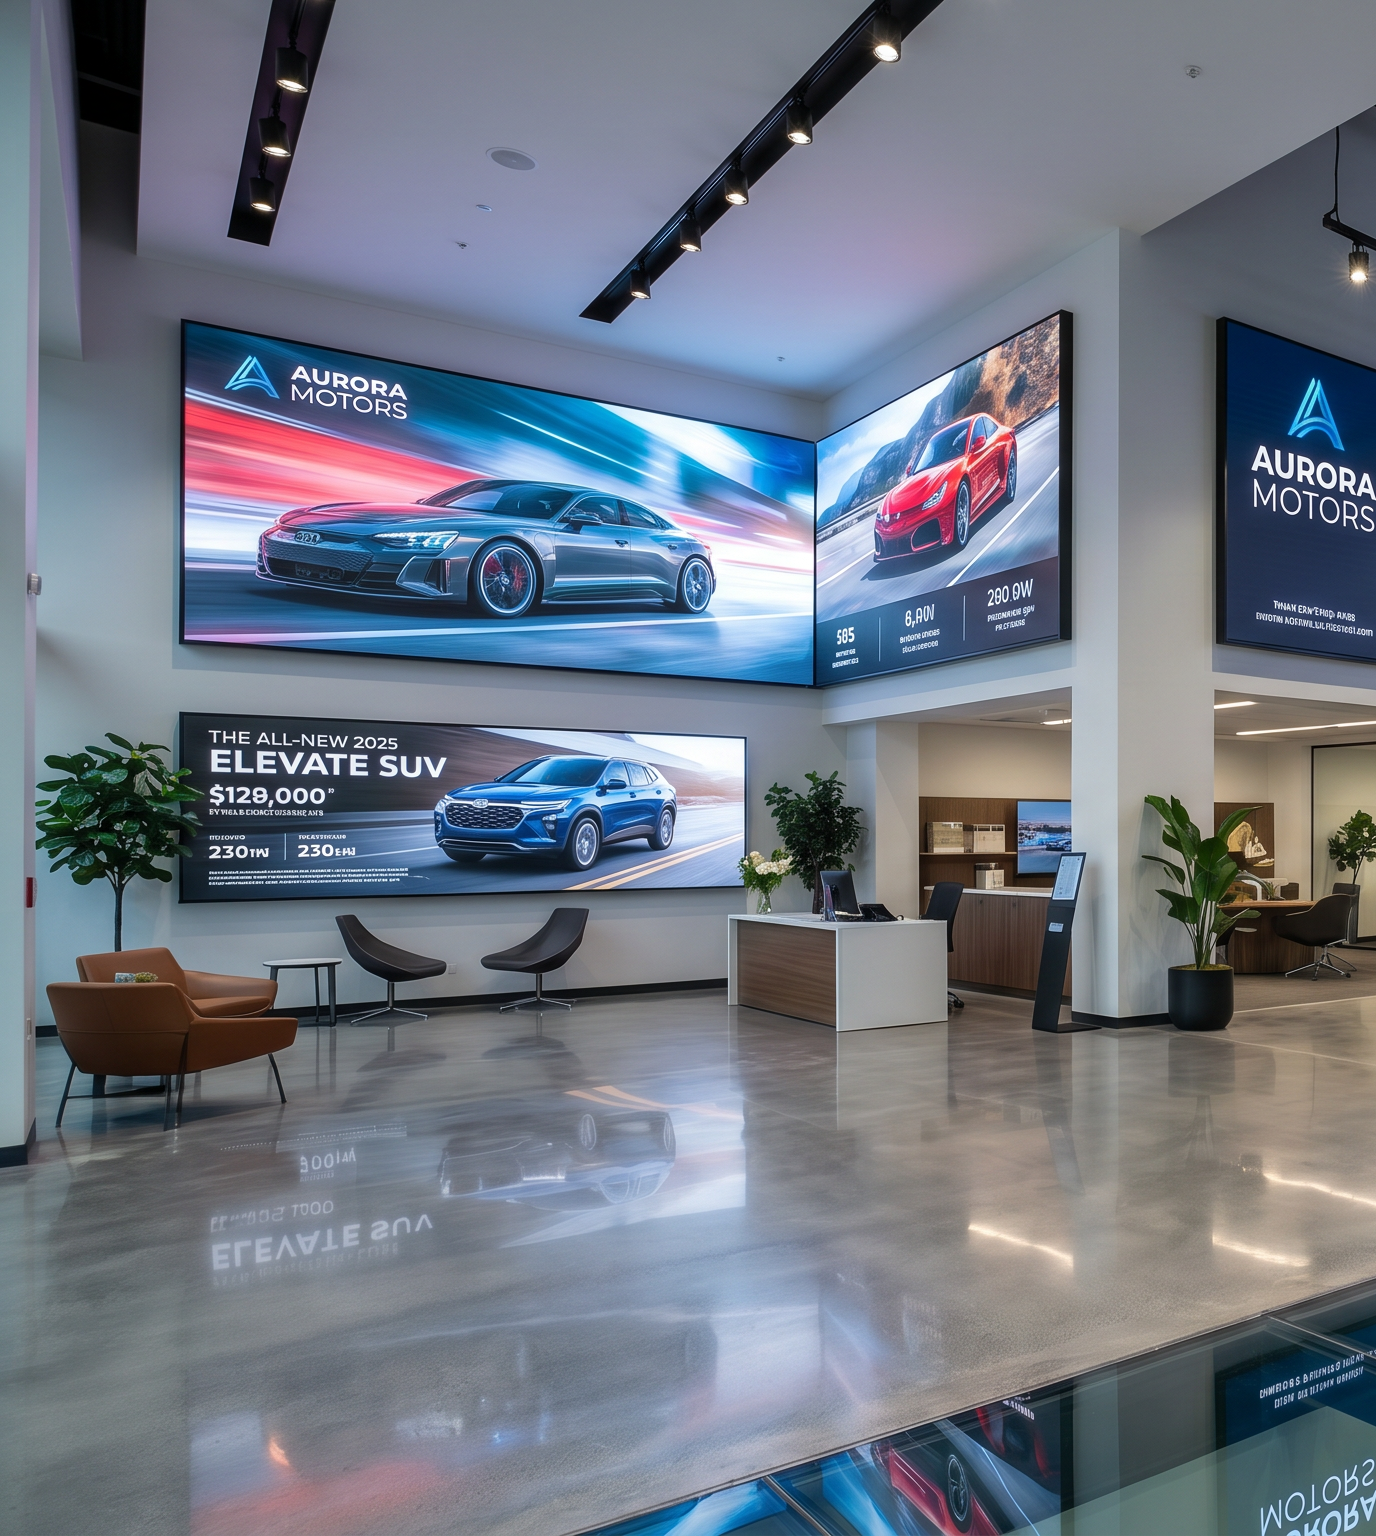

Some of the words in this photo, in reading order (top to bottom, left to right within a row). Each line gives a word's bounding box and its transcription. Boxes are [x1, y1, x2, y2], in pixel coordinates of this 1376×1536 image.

[290, 365, 408, 401] AURORA
[291, 383, 408, 420] MOTORS
[1251, 445, 1376, 501] AURORA
[1252, 478, 1376, 533] MOTORS
[208, 729, 251, 745] THE
[256, 732, 349, 748] ALL-NEW
[353, 736, 399, 750] 2025
[210, 749, 369, 776] ELEVATE
[379, 754, 447, 778] SUV
